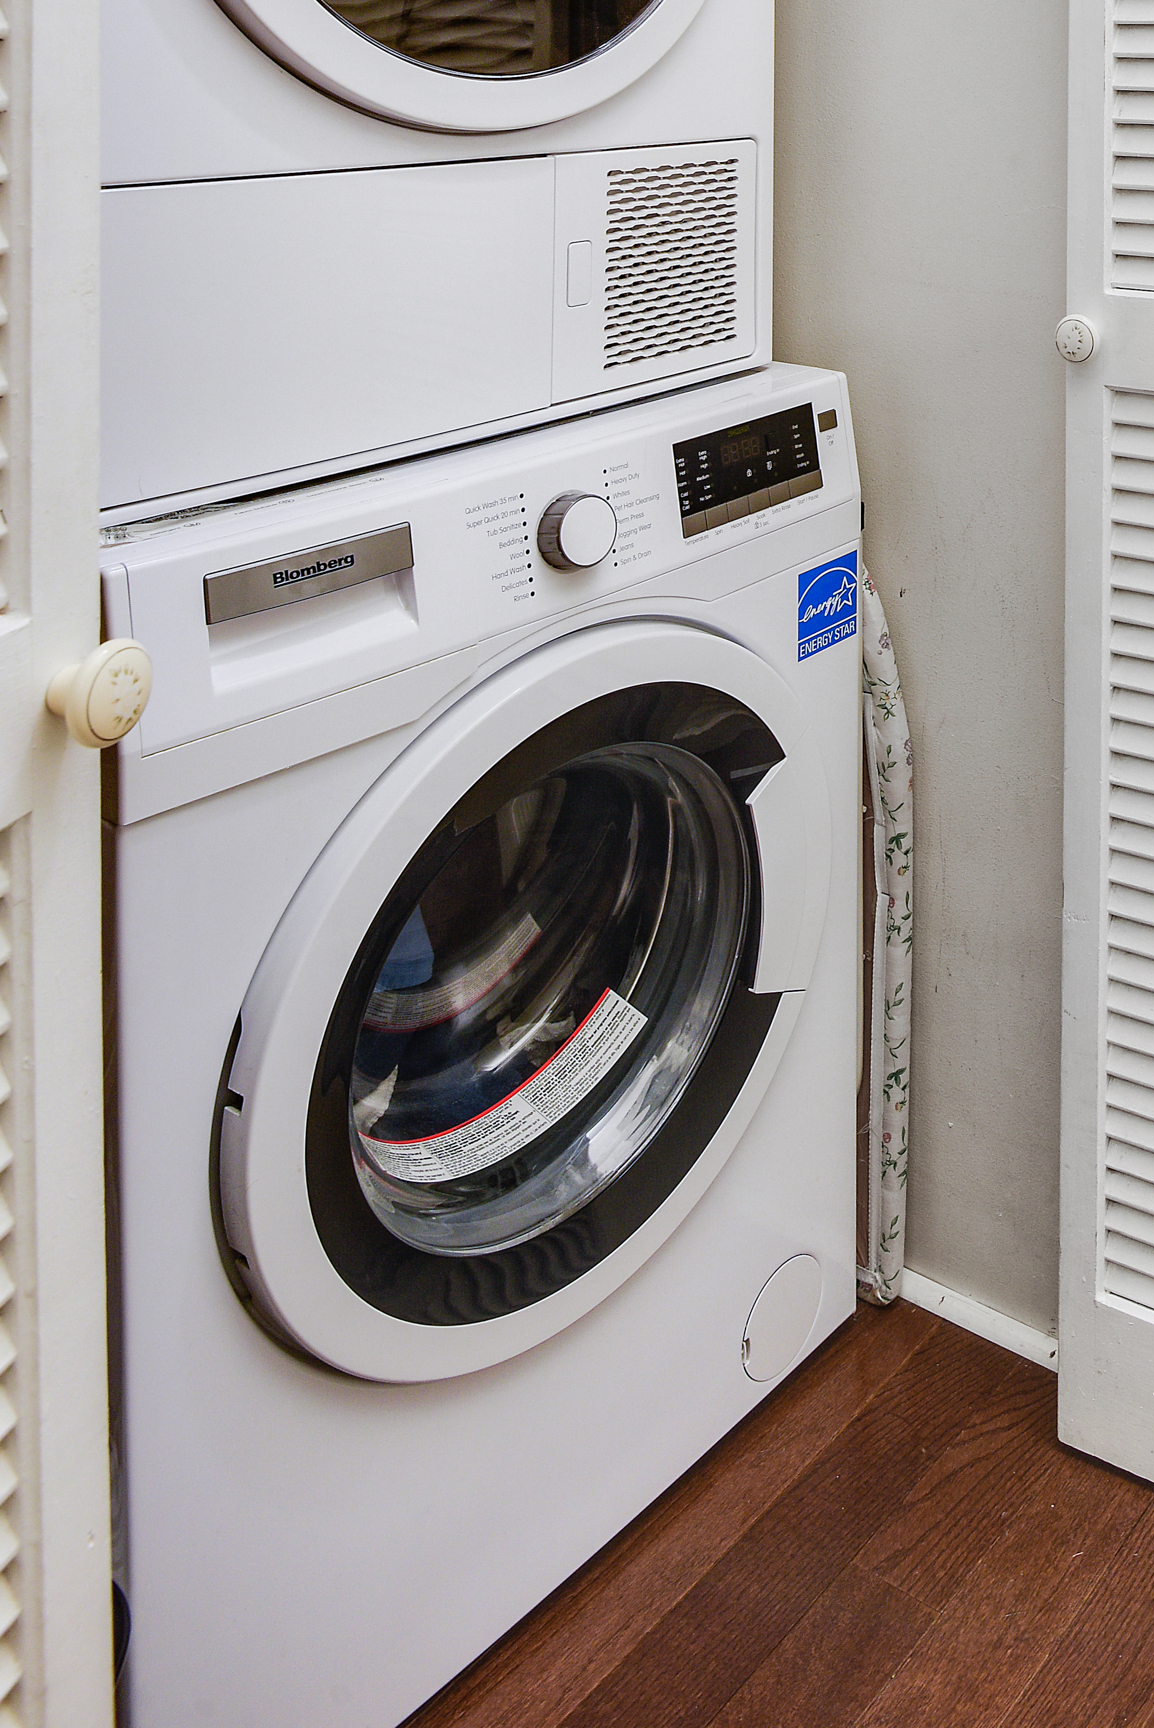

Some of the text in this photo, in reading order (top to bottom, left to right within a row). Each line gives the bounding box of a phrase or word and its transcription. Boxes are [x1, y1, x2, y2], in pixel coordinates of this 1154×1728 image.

[610, 462, 629, 472] Normal
[611, 472, 640, 485] Heavy Duty
[613, 489, 631, 500] Whites
[465, 504, 482, 515] Quick
[482, 500, 498, 510] Wash
[508, 494, 519, 502] min
[614, 493, 660, 512] Pet Hair Cleansing
[466, 508, 520, 529] Super Quick 20 min
[631, 512, 644, 520] Press
[487, 523, 521, 537] Tub Sanitize
[618, 522, 652, 539] Jogging Wear
[498, 536, 523, 549] Bedding
[619, 542, 634, 552] Jeans
[510, 550, 525, 560] Wool
[620, 556, 632, 566] Spin
[637, 549, 652, 559] Drain
[272, 554, 355, 588] Blomberg
[492, 564, 526, 580] Hand Wash
[501, 579, 528, 592] Delicates
[513, 592, 529, 602] Rinse
[800, 620, 855, 657] ENERGY STAR
